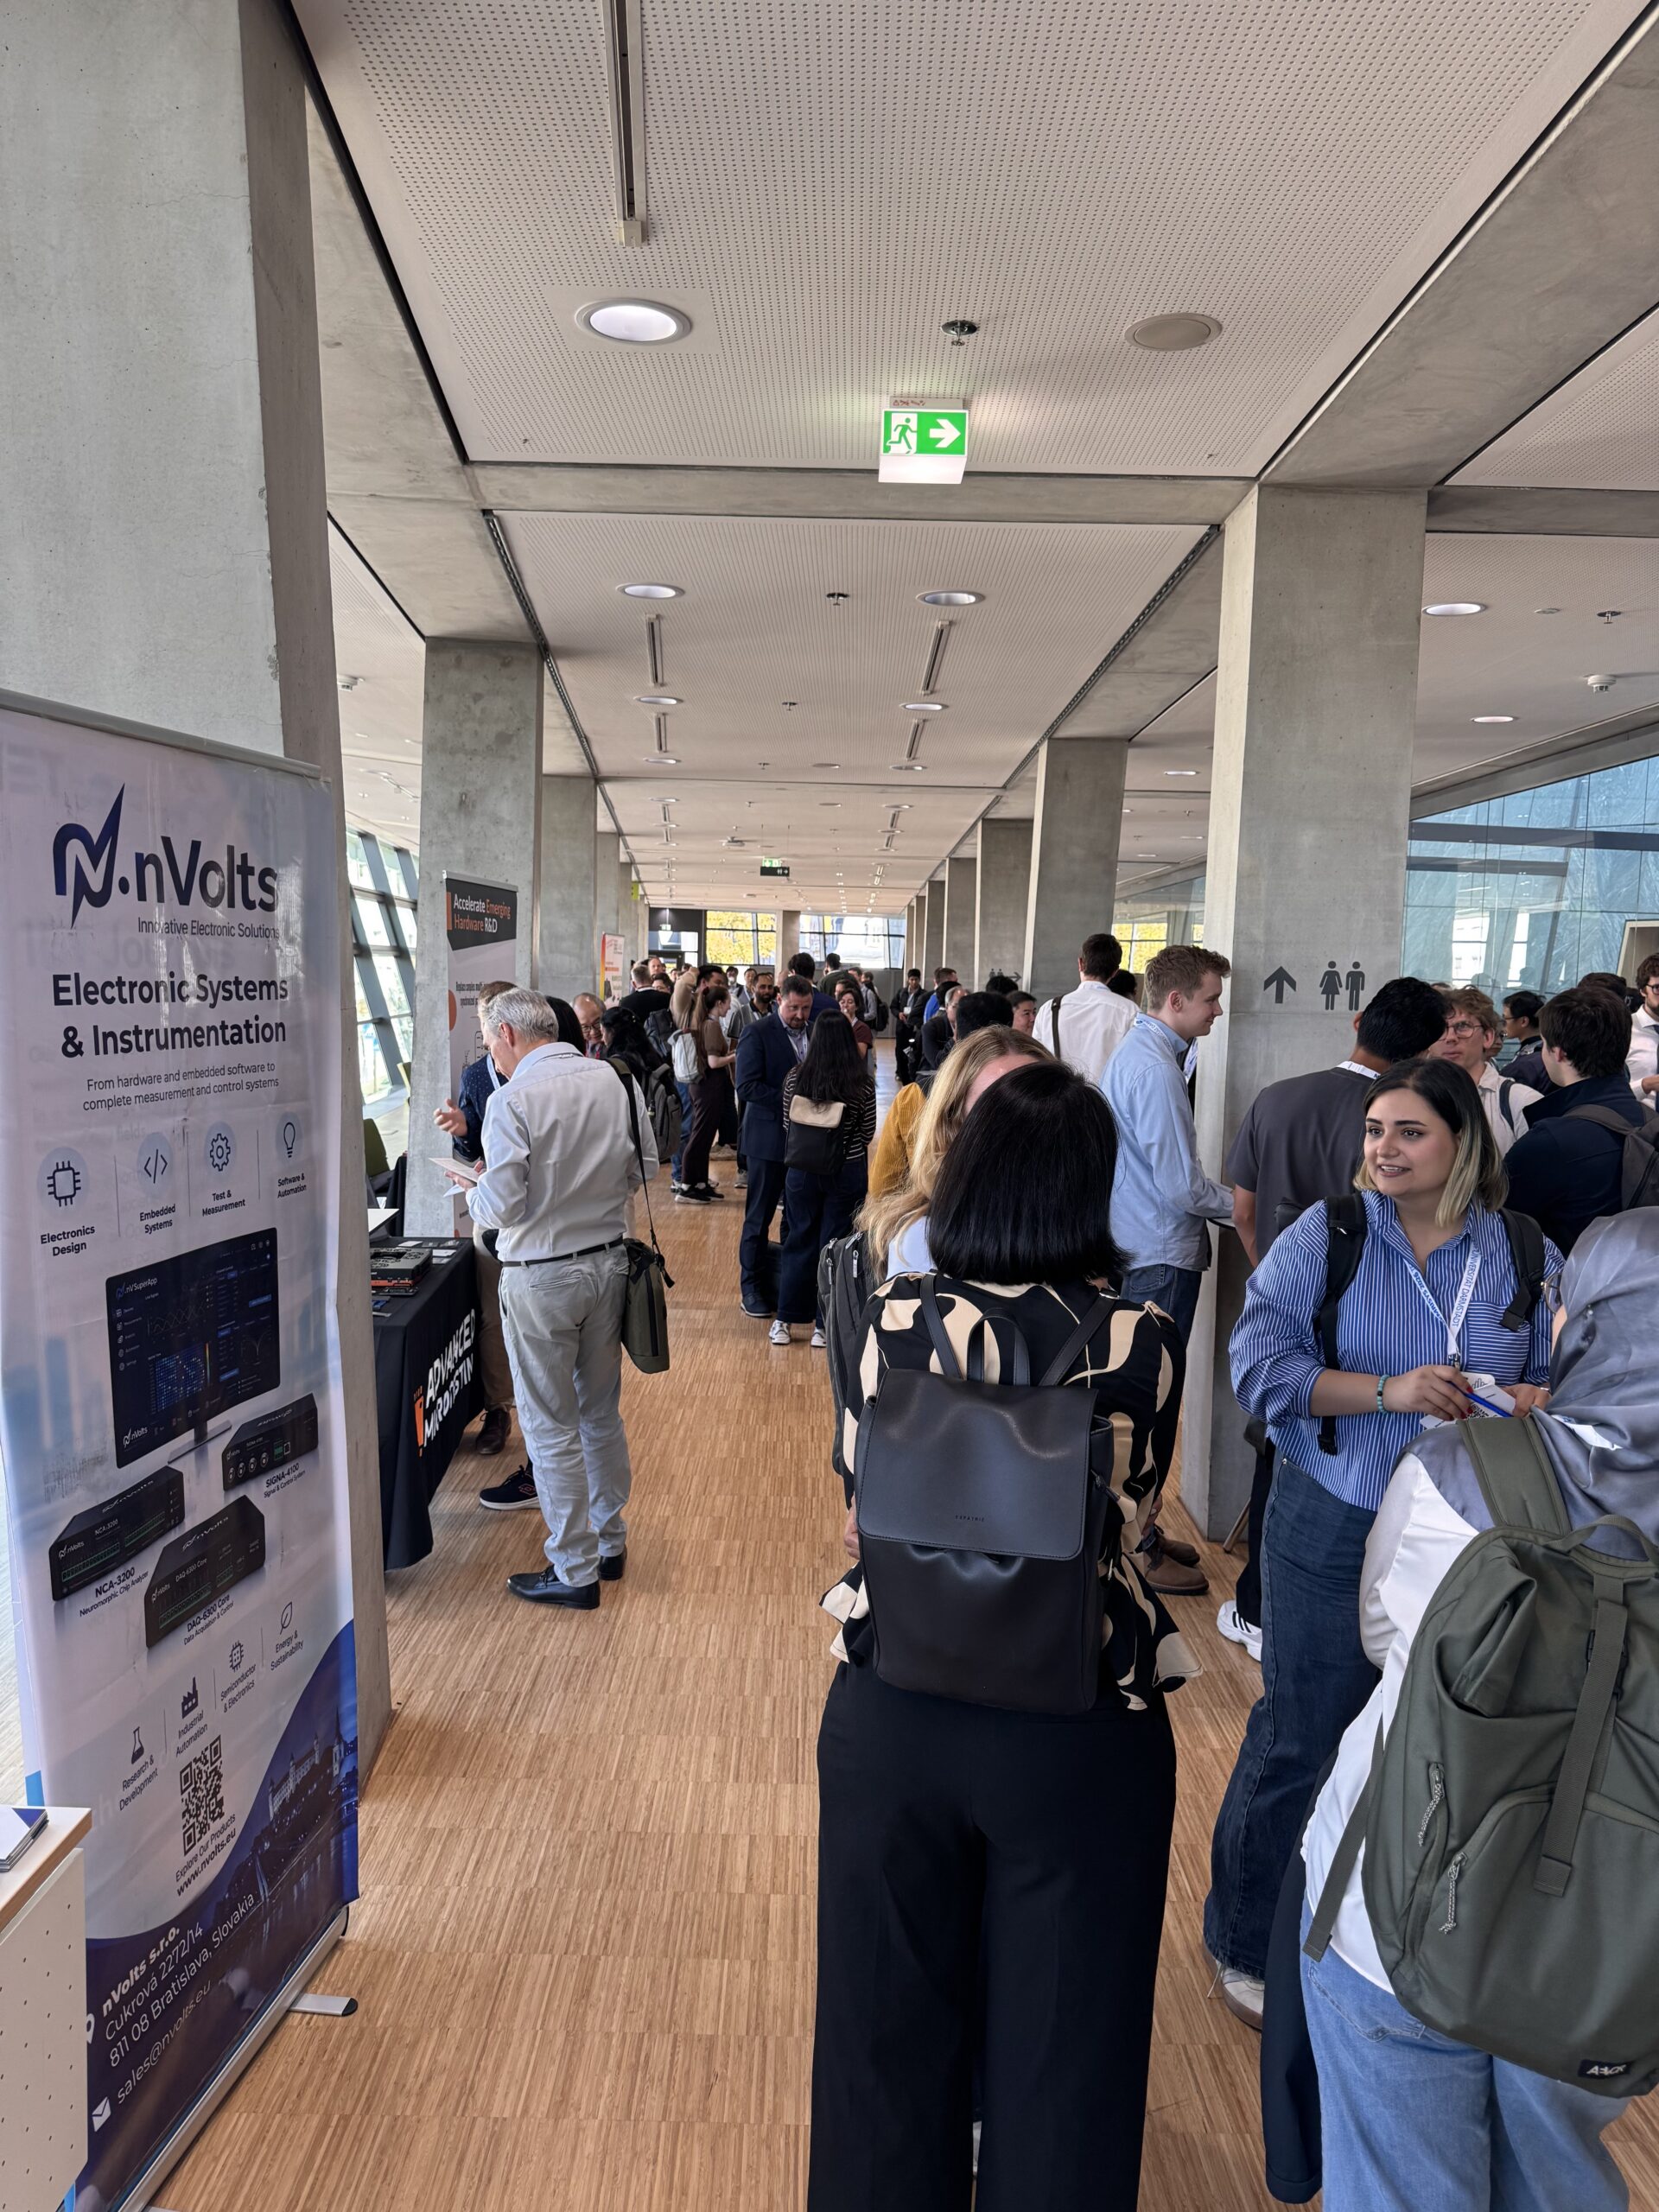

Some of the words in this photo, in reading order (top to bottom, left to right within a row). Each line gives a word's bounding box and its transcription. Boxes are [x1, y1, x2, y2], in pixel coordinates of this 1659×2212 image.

[135, 836, 278, 912] nVolts
[454, 893, 486, 913] Accelerate
[486, 899, 511, 919] Emerging
[138, 917, 188, 935] Innoative
[191, 920, 235, 938] Electronic
[238, 923, 280, 939] Solutions
[454, 913, 484, 931] Hardware
[485, 918, 498, 932] R&D
[53, 971, 189, 1006] Electronic
[196, 974, 289, 1008] Systems
[61, 1026, 84, 1058] &
[93, 1014, 286, 1056] Instrumentation
[87, 1078, 115, 1091] From
[118, 1072, 162, 1089] hardware
[165, 1070, 181, 1083] and
[182, 1065, 226, 1081] embedded
[227, 1062, 265, 1076] software
[267, 1062, 276, 1072] to
[83, 1094, 131, 1111] complete
[134, 1087, 194, 1104] measurement
[196, 1084, 212, 1096] and
[213, 1080, 244, 1093] control
[245, 1077, 279, 1091] systems
[213, 1192, 225, 1202] Test
[226, 1190, 232, 1198] &
[277, 1185, 307, 1198] Automation
[278, 1175, 301, 1187] Software
[139, 1205, 175, 1222] Embedded
[202, 1199, 245, 1217] Measurement
[41, 1224, 95, 1245] Electronics
[144, 1218, 173, 1234] Systems
[53, 1241, 86, 1256] Design
[1414, 1271, 1425, 1291] 2026
[1452, 1287, 1470, 1327] DARMSTADT
[426, 1308, 475, 1409] ADVANCED
[131, 1427, 148, 1440] nVolts
[264, 1489, 276, 1498] Signal
[280, 1478, 294, 1489] Control
[265, 1463, 300, 1488] SIGNA-4100
[95, 1519, 118, 1535] NCA-3200
[67, 1541, 85, 1554] nVolts
[95, 1567, 135, 1598] NCA-3200
[175, 1563, 197, 1582] DAQ-6300
[196, 1558, 207, 1569] Core
[79, 1590, 118, 1617] Neuromorphic
[119, 1583, 130, 1594] Chip
[130, 1571, 149, 1587] Analyzer
[184, 1634, 194, 1645] Data
[195, 1616, 217, 1637] Acquisition
[220, 1600, 234, 1616] Control
[187, 1604, 217, 1632] DAQ-6300
[218, 1594, 230, 1608] Core
[270, 1639, 303, 1670] Sustainability
[276, 1636, 293, 1654] Energy
[294, 1630, 298, 1640] &
[220, 1663, 257, 1701] Semiconductor
[224, 1703, 228, 1713] &
[228, 1680, 255, 1711] Electronics
[175, 1723, 208, 1757] Automation
[178, 1710, 204, 1739] Industrial
[123, 1760, 149, 1791] Research
[149, 1755, 155, 1765] &
[119, 1769, 158, 1811] Development
[175, 1853, 198, 1883] Explore
[200, 1843, 210, 1859] Our
[211, 1814, 236, 1847] Products
[176, 1827, 237, 1896] www.nvolts.eu
[102, 1961, 146, 2017] nVolts
[149, 1928, 181, 1962] s.r.o.
[105, 1971, 158, 2041] Cukrová
[159, 1922, 204, 1978] 2272/14
[111, 2040, 130, 2068] 811
[132, 2018, 149, 2044] 08
[151, 1947, 213, 2025] Bratislava,
[213, 1893, 255, 1950] Slovakia
[118, 1980, 212, 2104] sales@nvolts.eu
